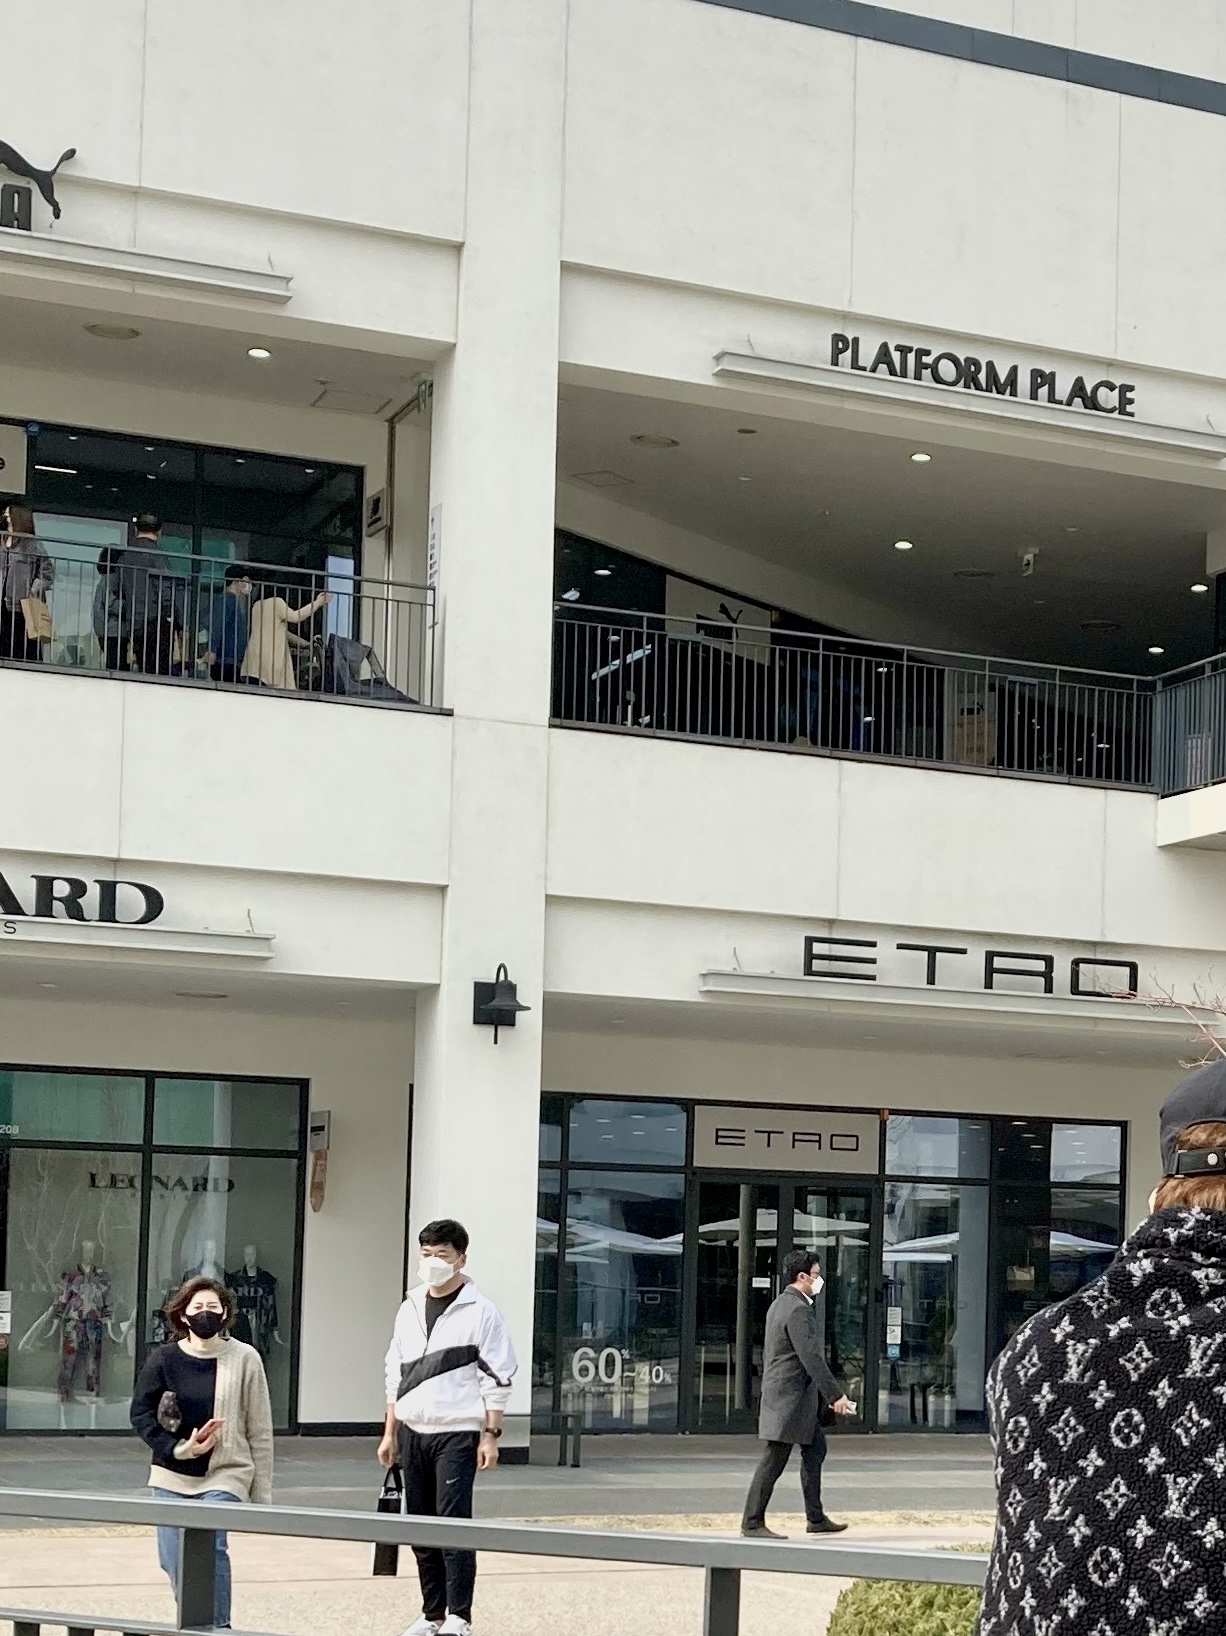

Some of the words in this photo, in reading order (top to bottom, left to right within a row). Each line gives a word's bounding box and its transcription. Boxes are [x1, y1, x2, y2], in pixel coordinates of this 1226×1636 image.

[830, 332, 1019, 398] PLATFORM
[1029, 367, 1136, 418] PLACE
[803, 935, 1139, 999] ETRO
[715, 1127, 860, 1152] ETRO
